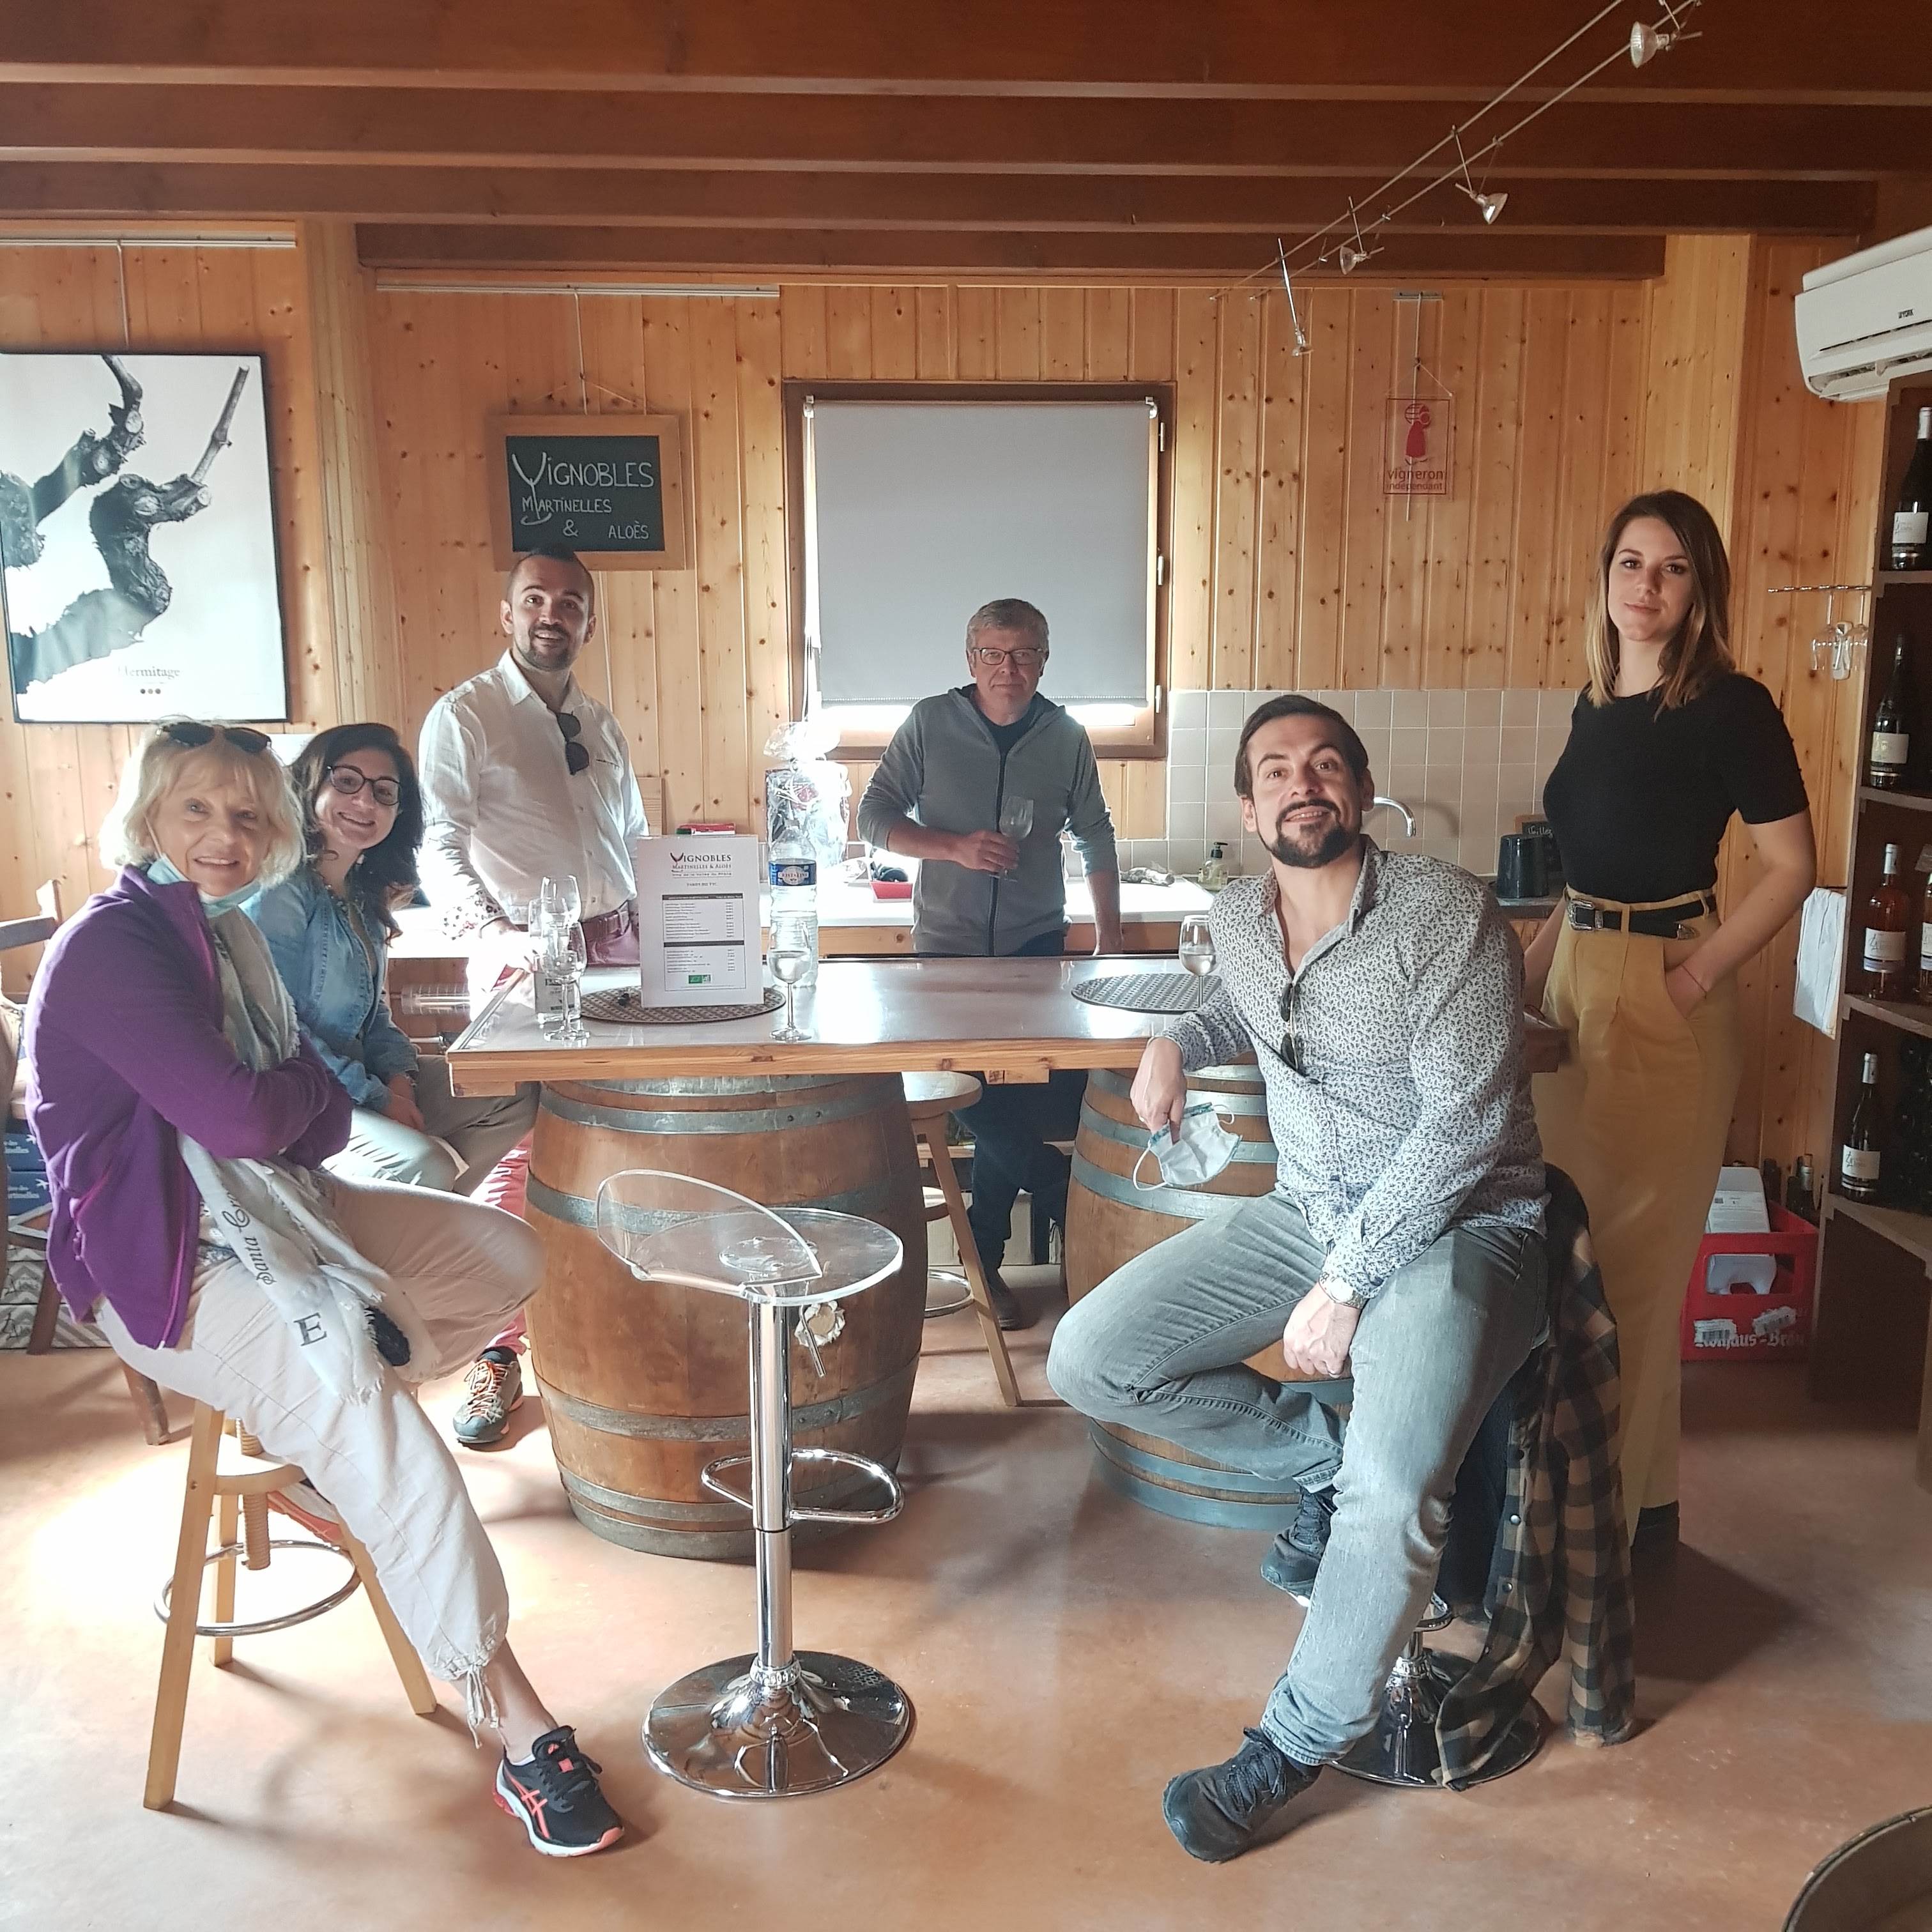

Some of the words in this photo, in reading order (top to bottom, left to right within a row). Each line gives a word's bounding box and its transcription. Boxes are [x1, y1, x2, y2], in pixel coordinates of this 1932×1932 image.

[1388, 468, 1443, 484] vigneron
[562, 519, 579, 537] &
[670, 852, 732, 862] VIGNOBLES
[293, 1312, 328, 1347] E
